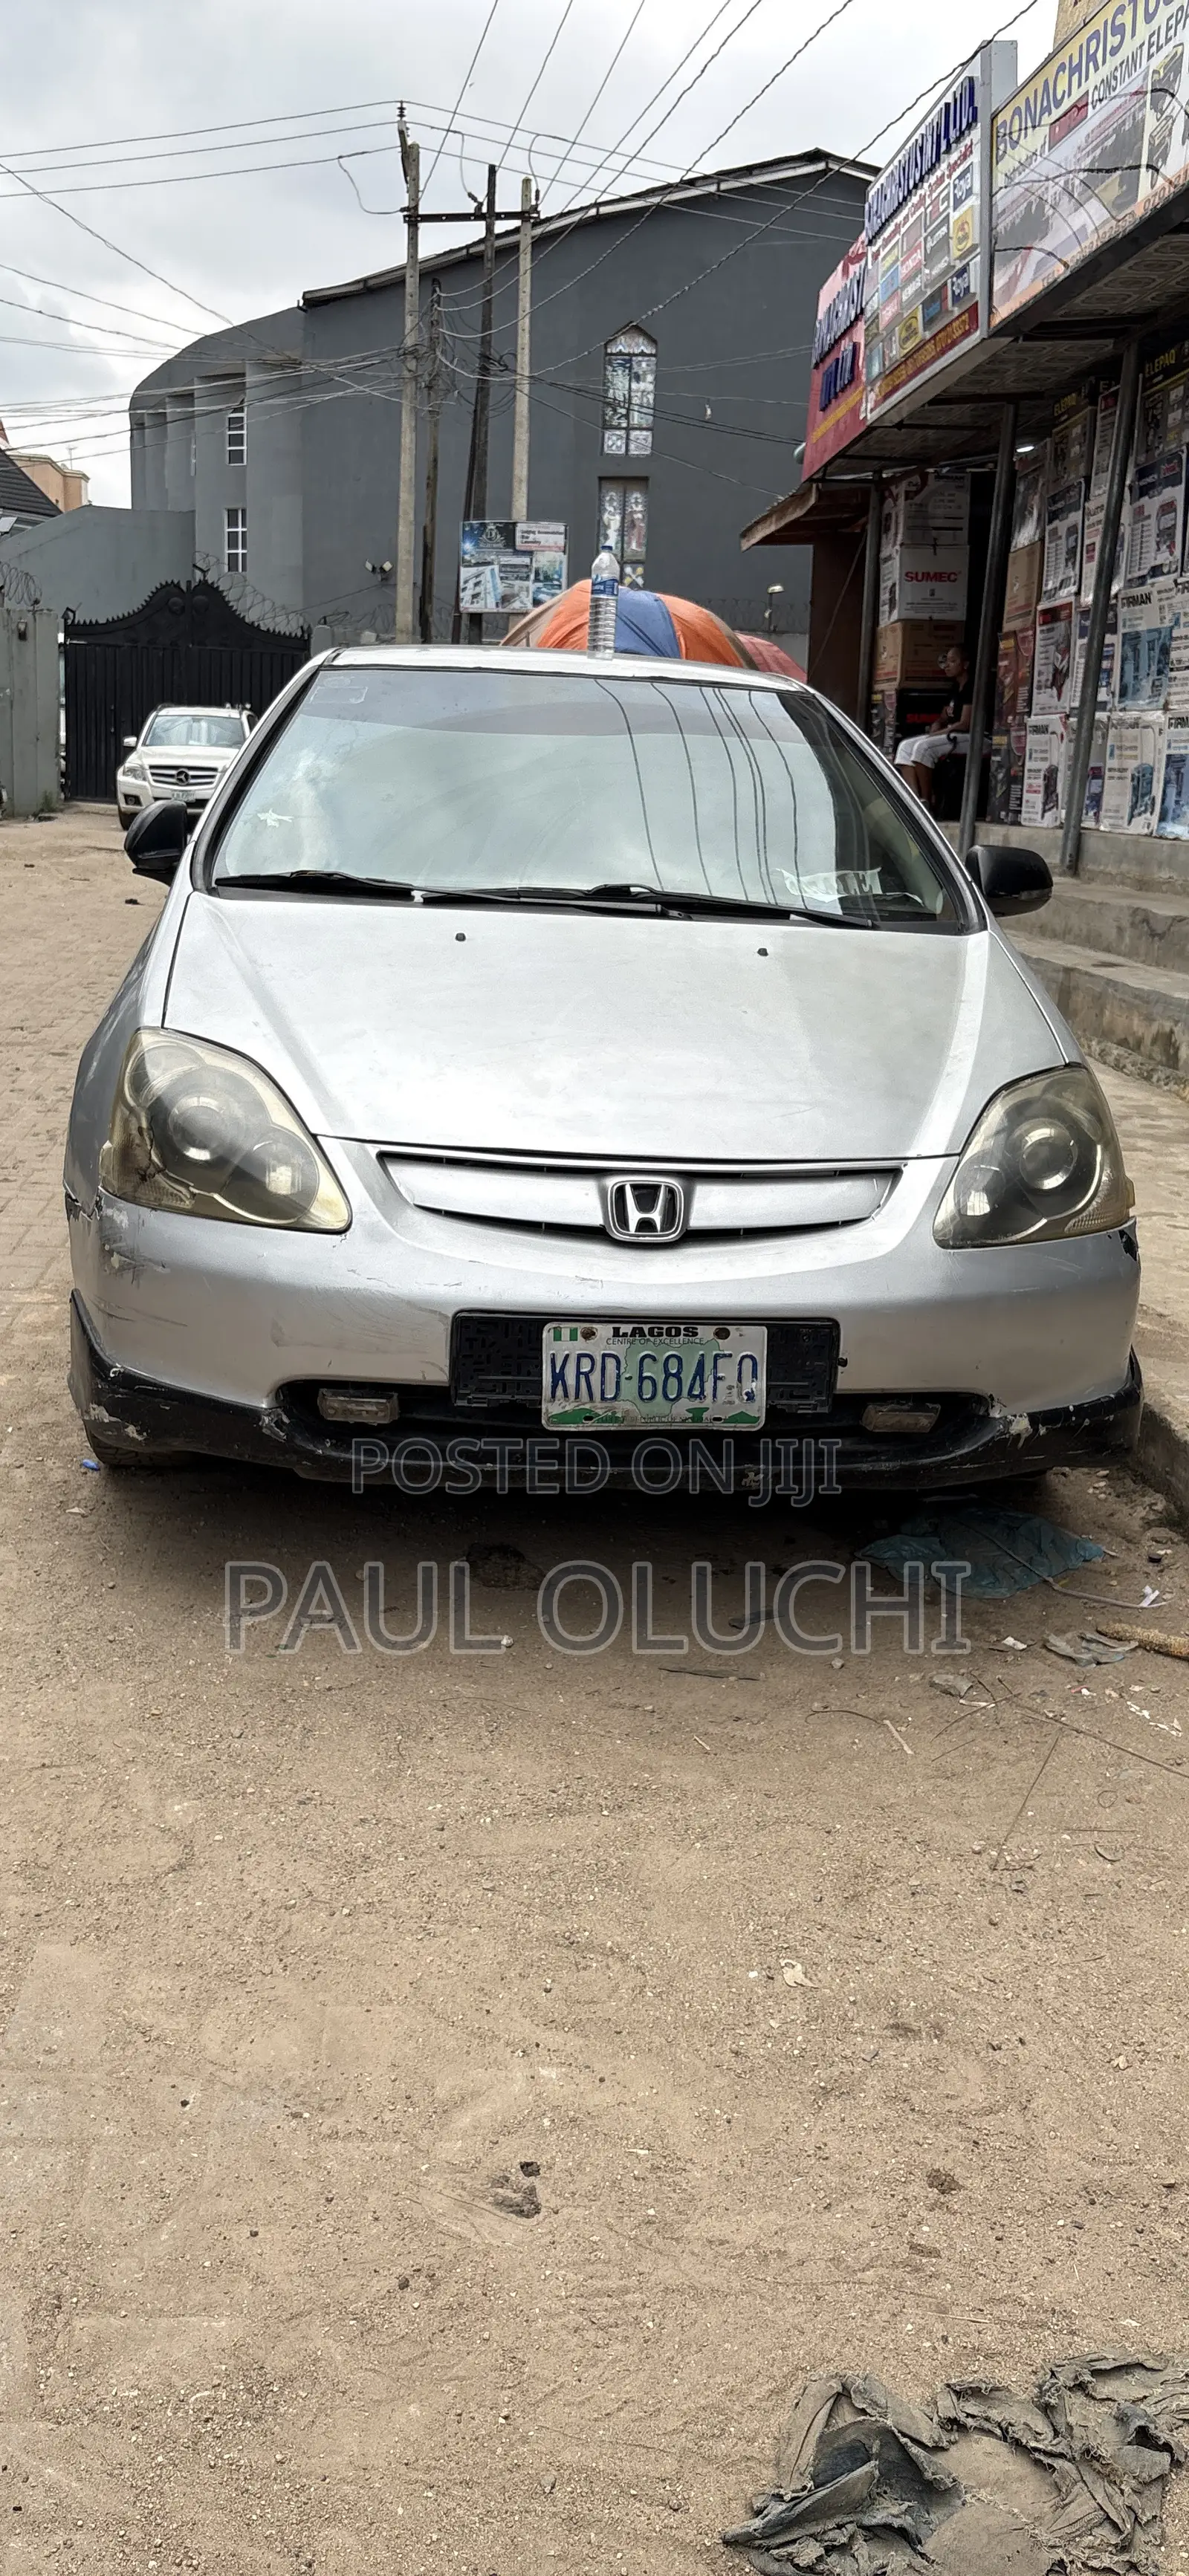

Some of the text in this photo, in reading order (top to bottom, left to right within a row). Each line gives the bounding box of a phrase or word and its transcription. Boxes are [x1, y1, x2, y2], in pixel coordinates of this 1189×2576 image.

[995, 0, 1175, 166] BONACHRIST
[1091, 42, 1145, 110] CONSTANT
[1145, 349, 1176, 377] ELEPAQ
[904, 571, 958, 583] SUMEC
[1120, 591, 1151, 609] FIRMAN
[606, 1337, 704, 1346] CENTRE OF EXCELLENCE
[612, 1326, 699, 1339] LAGOS
